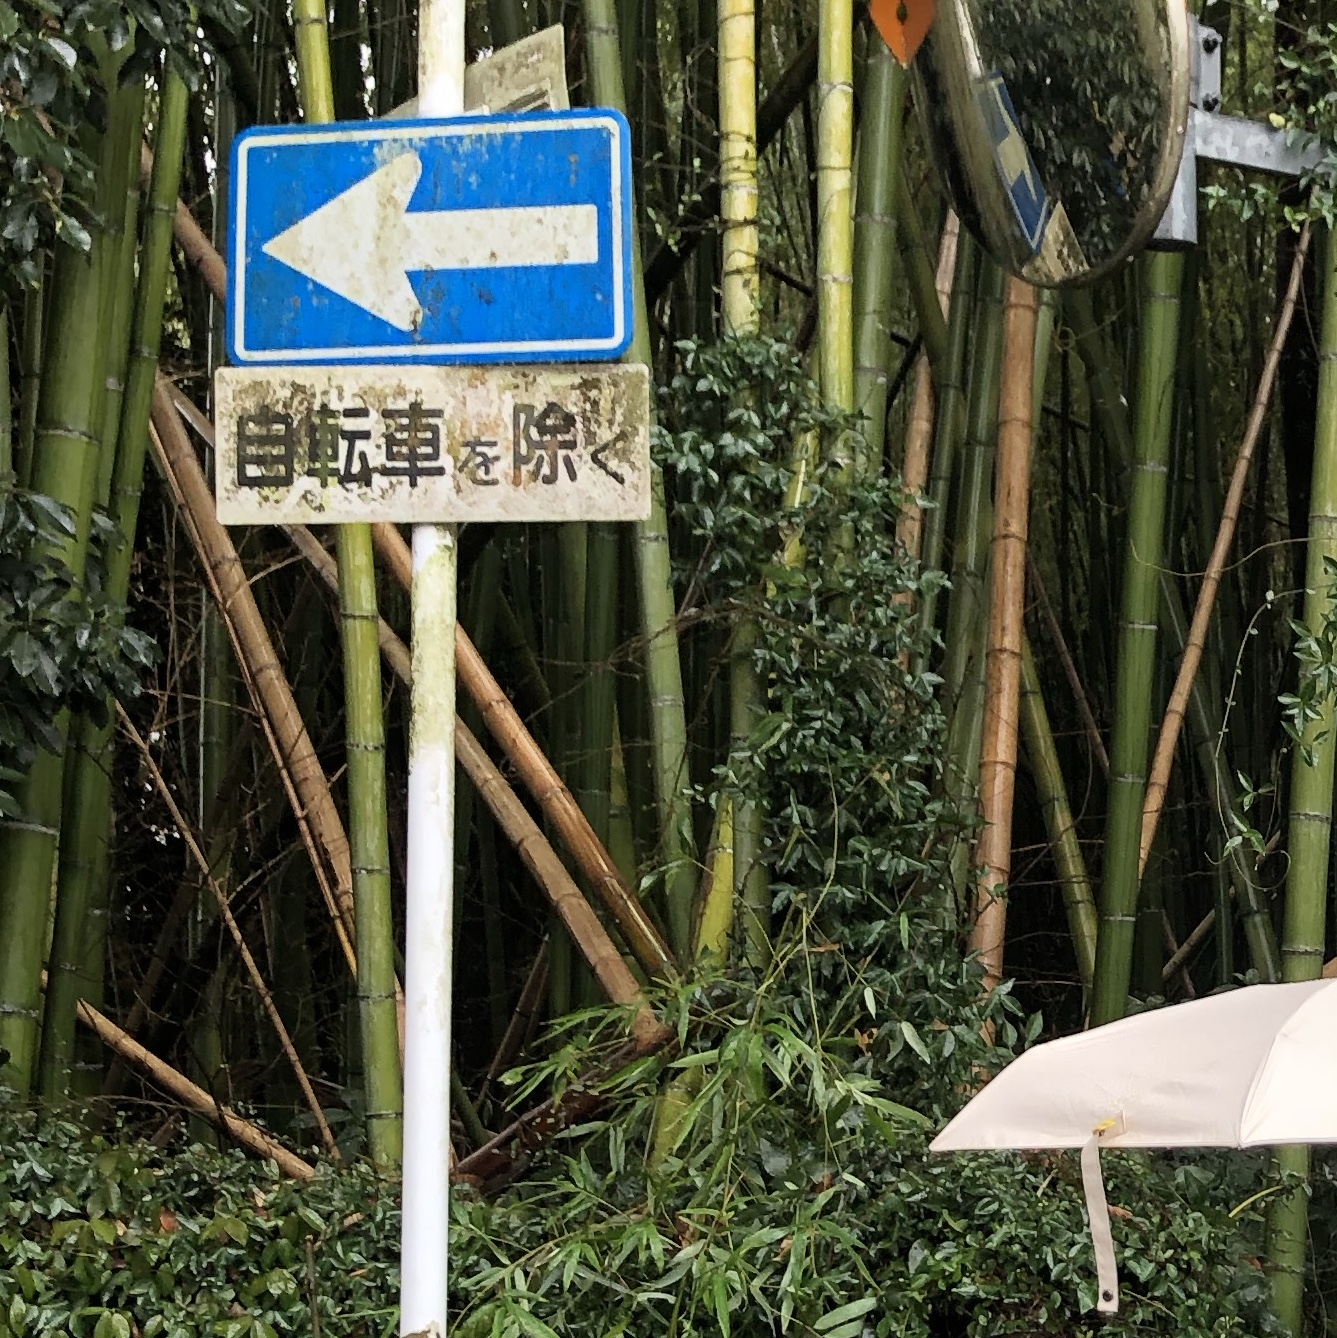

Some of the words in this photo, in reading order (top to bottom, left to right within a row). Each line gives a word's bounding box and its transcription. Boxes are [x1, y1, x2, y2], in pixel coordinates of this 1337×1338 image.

[237, 401, 627, 488] 自転車を除く
